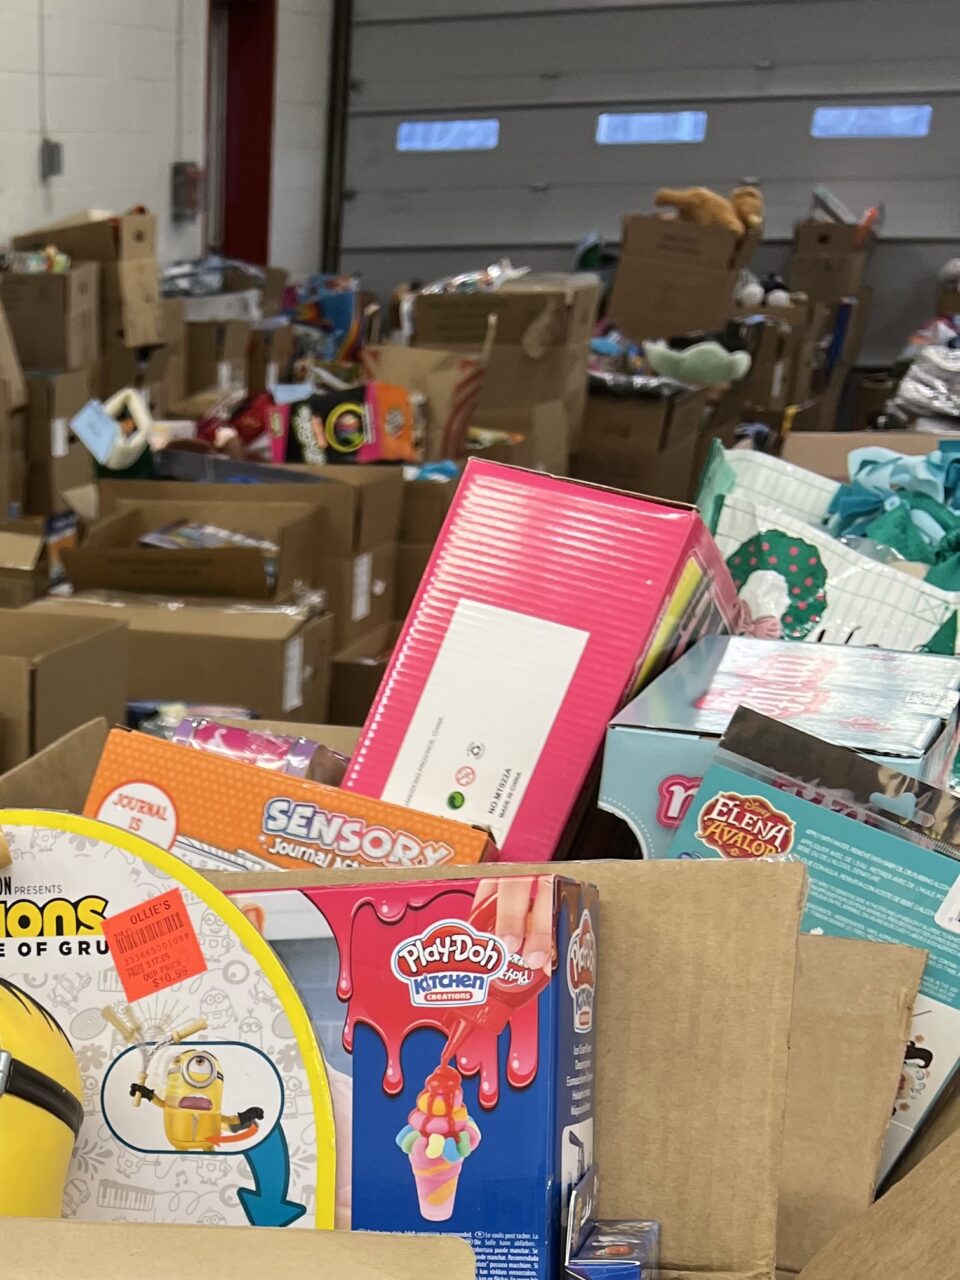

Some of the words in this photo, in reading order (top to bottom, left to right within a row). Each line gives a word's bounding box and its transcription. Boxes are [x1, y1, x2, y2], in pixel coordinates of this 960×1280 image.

[112, 793, 168, 821] JOURNAL
[128, 816, 143, 831] IS
[264, 797, 452, 867] SENSORY
[704, 796, 790, 853] ELENA
[267, 837, 333, 869] Journal
[14, 884, 63, 896] PRESENTS
[129, 900, 172, 926] OLLIE'S
[17, 941, 48, 957] OF
[59, 939, 110, 957] GRU
[399, 933, 500, 973] Play-Doh
[413, 974, 485, 995] KITCHEN
[426, 992, 471, 1001] CREATIONS
